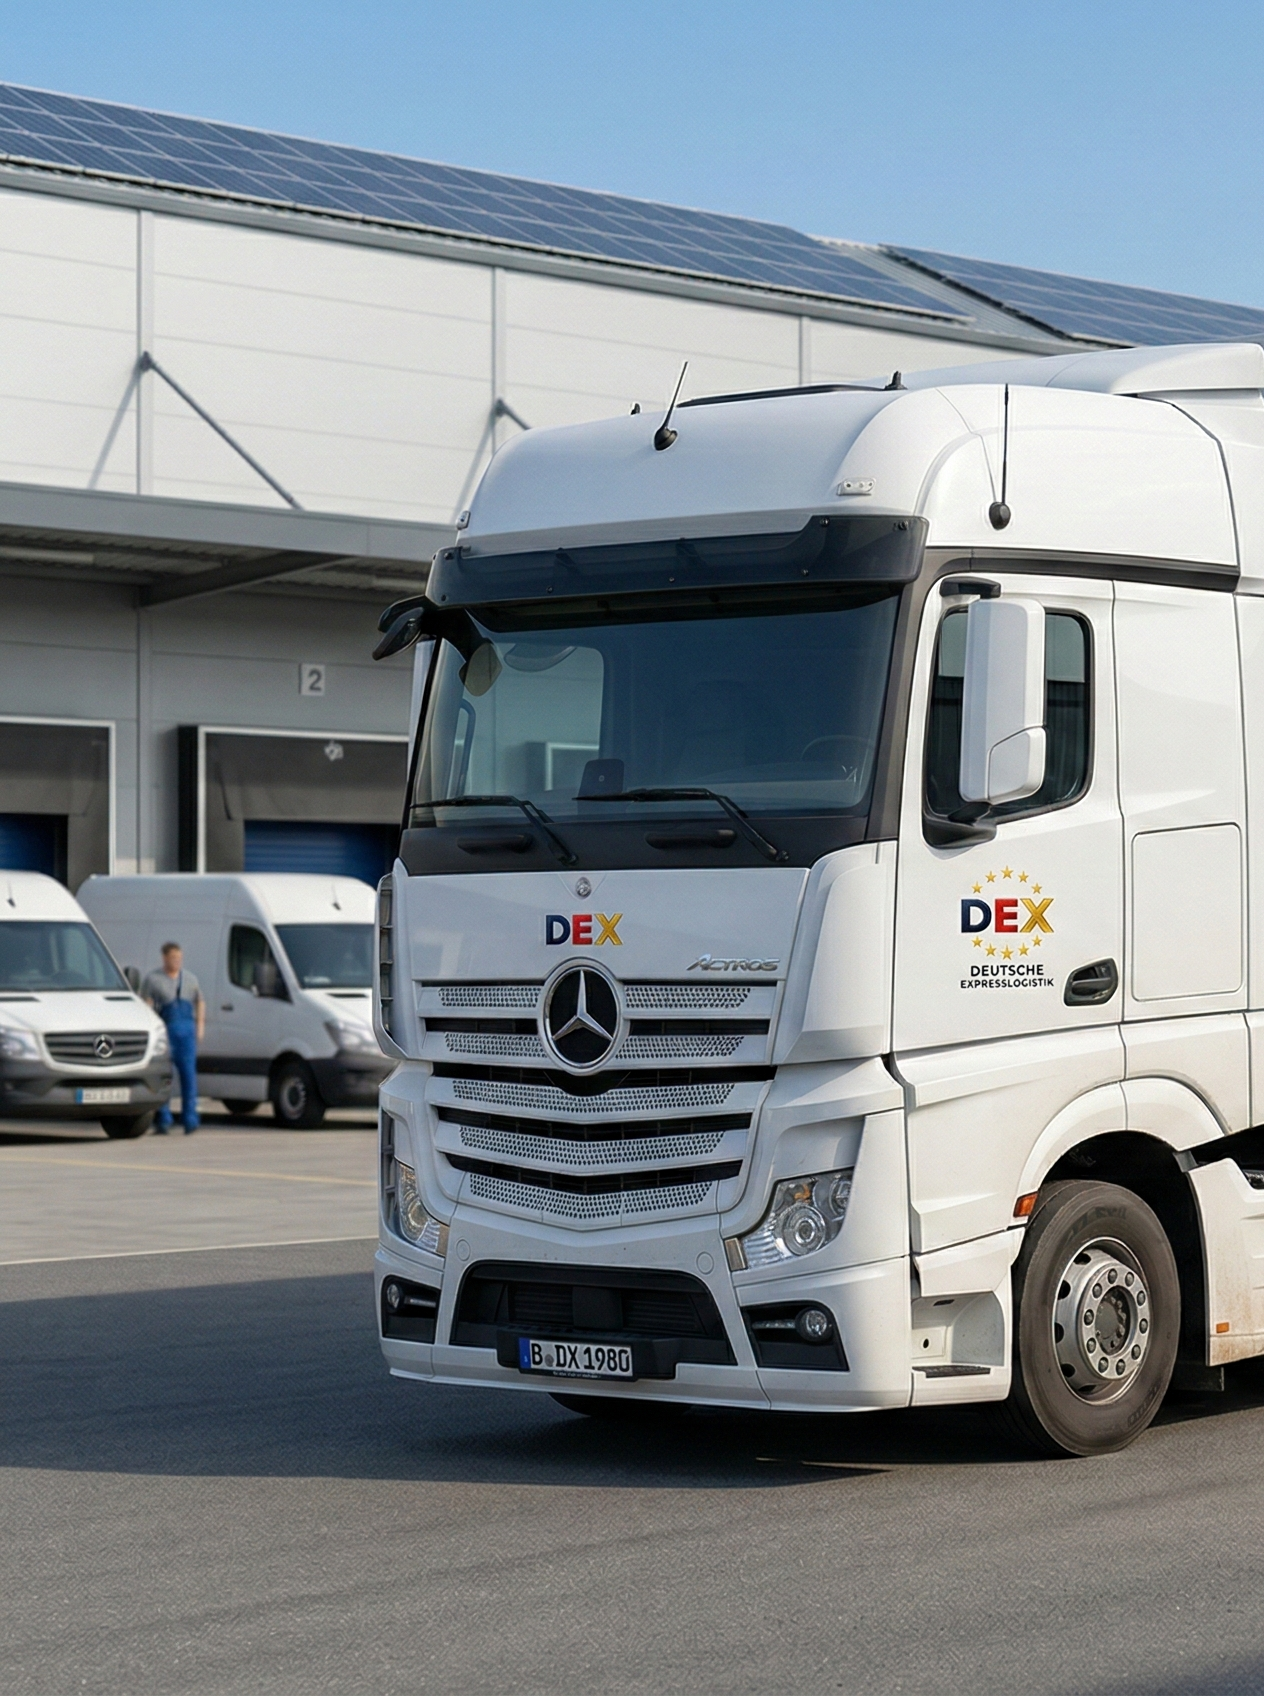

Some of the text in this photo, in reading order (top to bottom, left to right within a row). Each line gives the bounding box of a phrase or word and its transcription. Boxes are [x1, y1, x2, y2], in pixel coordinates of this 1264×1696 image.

[308, 668, 322, 691] 2
[961, 898, 1054, 933] DEX
[545, 913, 623, 946] DEX
[960, 978, 1055, 989] EXPRESSLOGISTIK
[970, 964, 1044, 977] DEUTSCHE
[531, 1343, 630, 1373] B DX 1980
